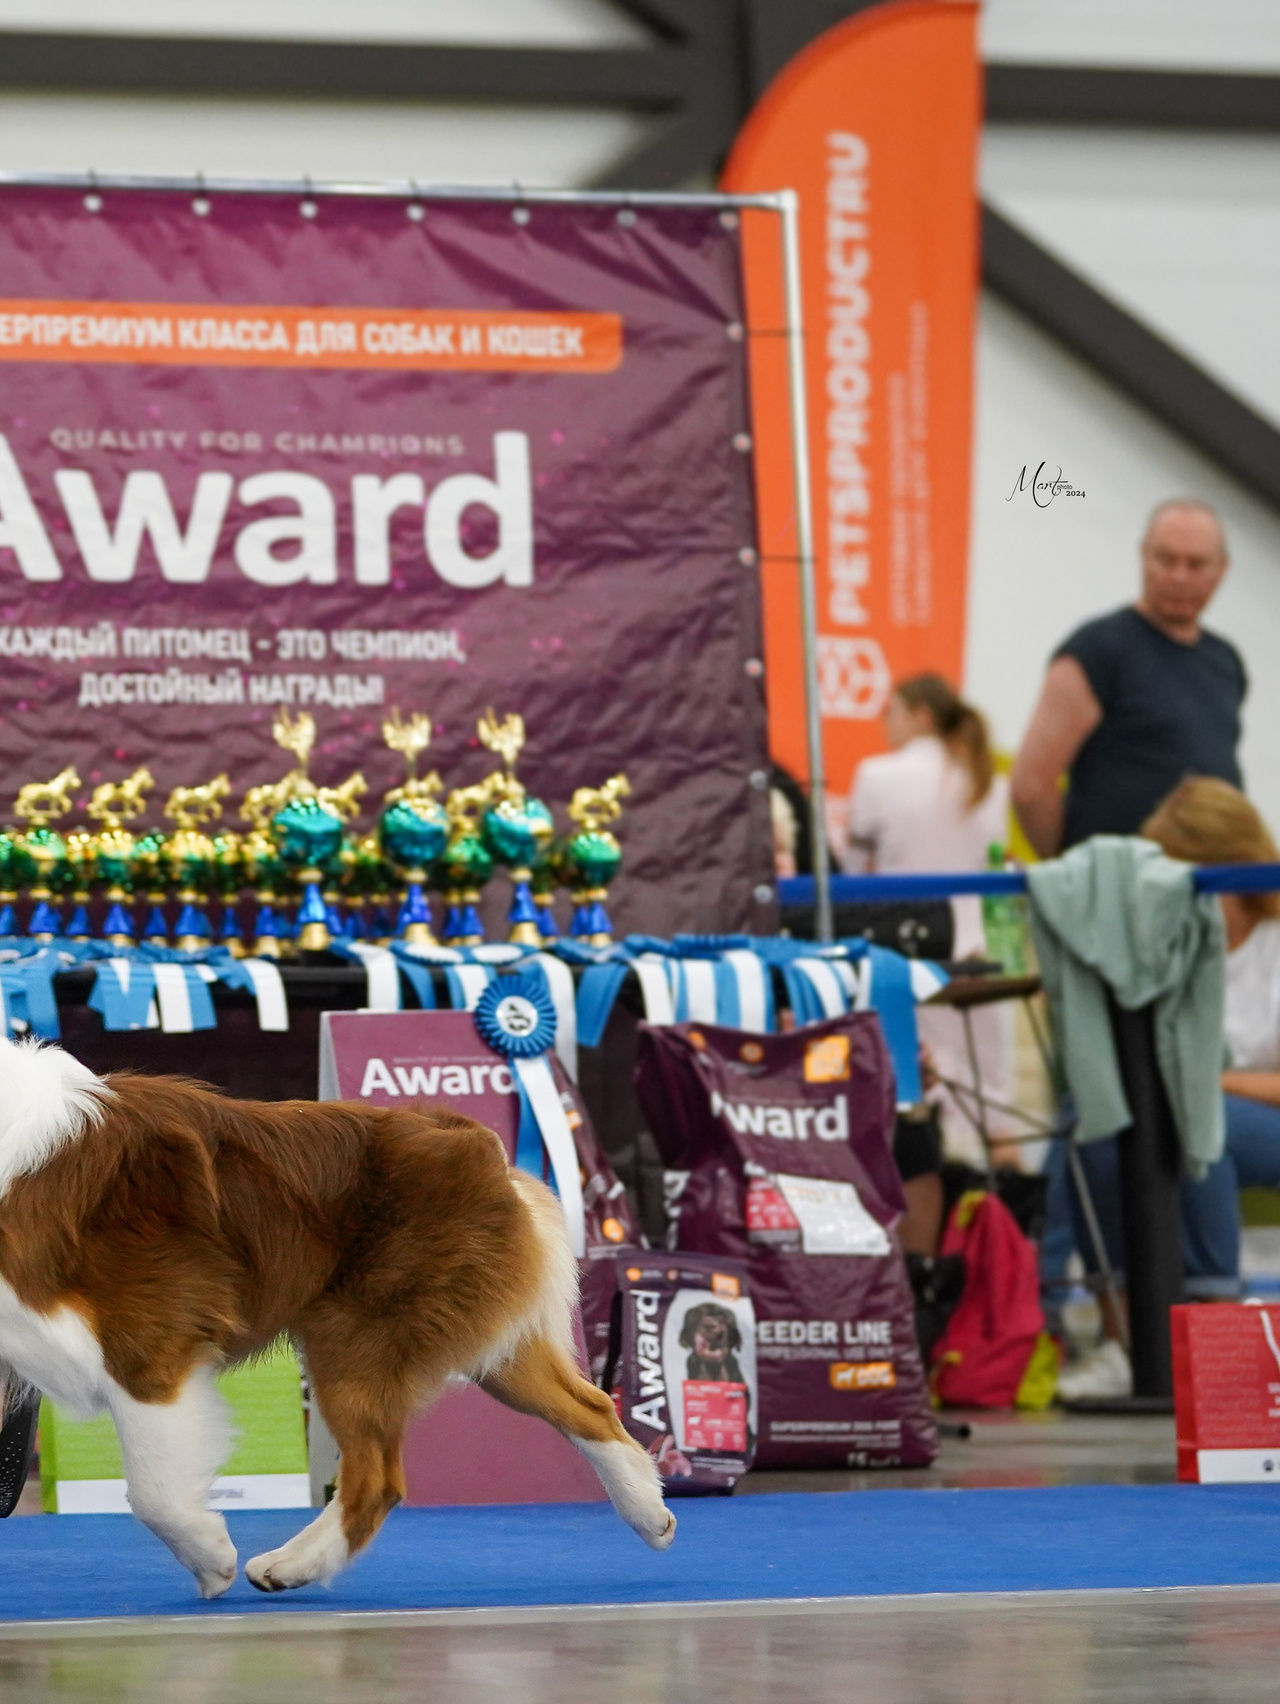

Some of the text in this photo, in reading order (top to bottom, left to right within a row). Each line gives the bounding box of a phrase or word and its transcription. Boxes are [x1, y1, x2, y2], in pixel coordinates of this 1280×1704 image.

[178, 317, 290, 352] КЛАССА
[296, 320, 357, 357] ДЛЯ
[362, 322, 455, 355] СОБАК
[459, 325, 482, 355] И
[487, 326, 585, 358] КОШЕК
[49, 427, 466, 456] QUALITY FOR CHAMPIONS
[122, 628, 252, 664] ПИТОМЕЦ
[277, 628, 327, 661] ЭТО
[77, 666, 246, 707] ДОСТОЙНЫЙ
[843, 1320, 892, 1345] LINE
[628, 1290, 667, 1432] Award
[857, 1367, 891, 1386] DOG
